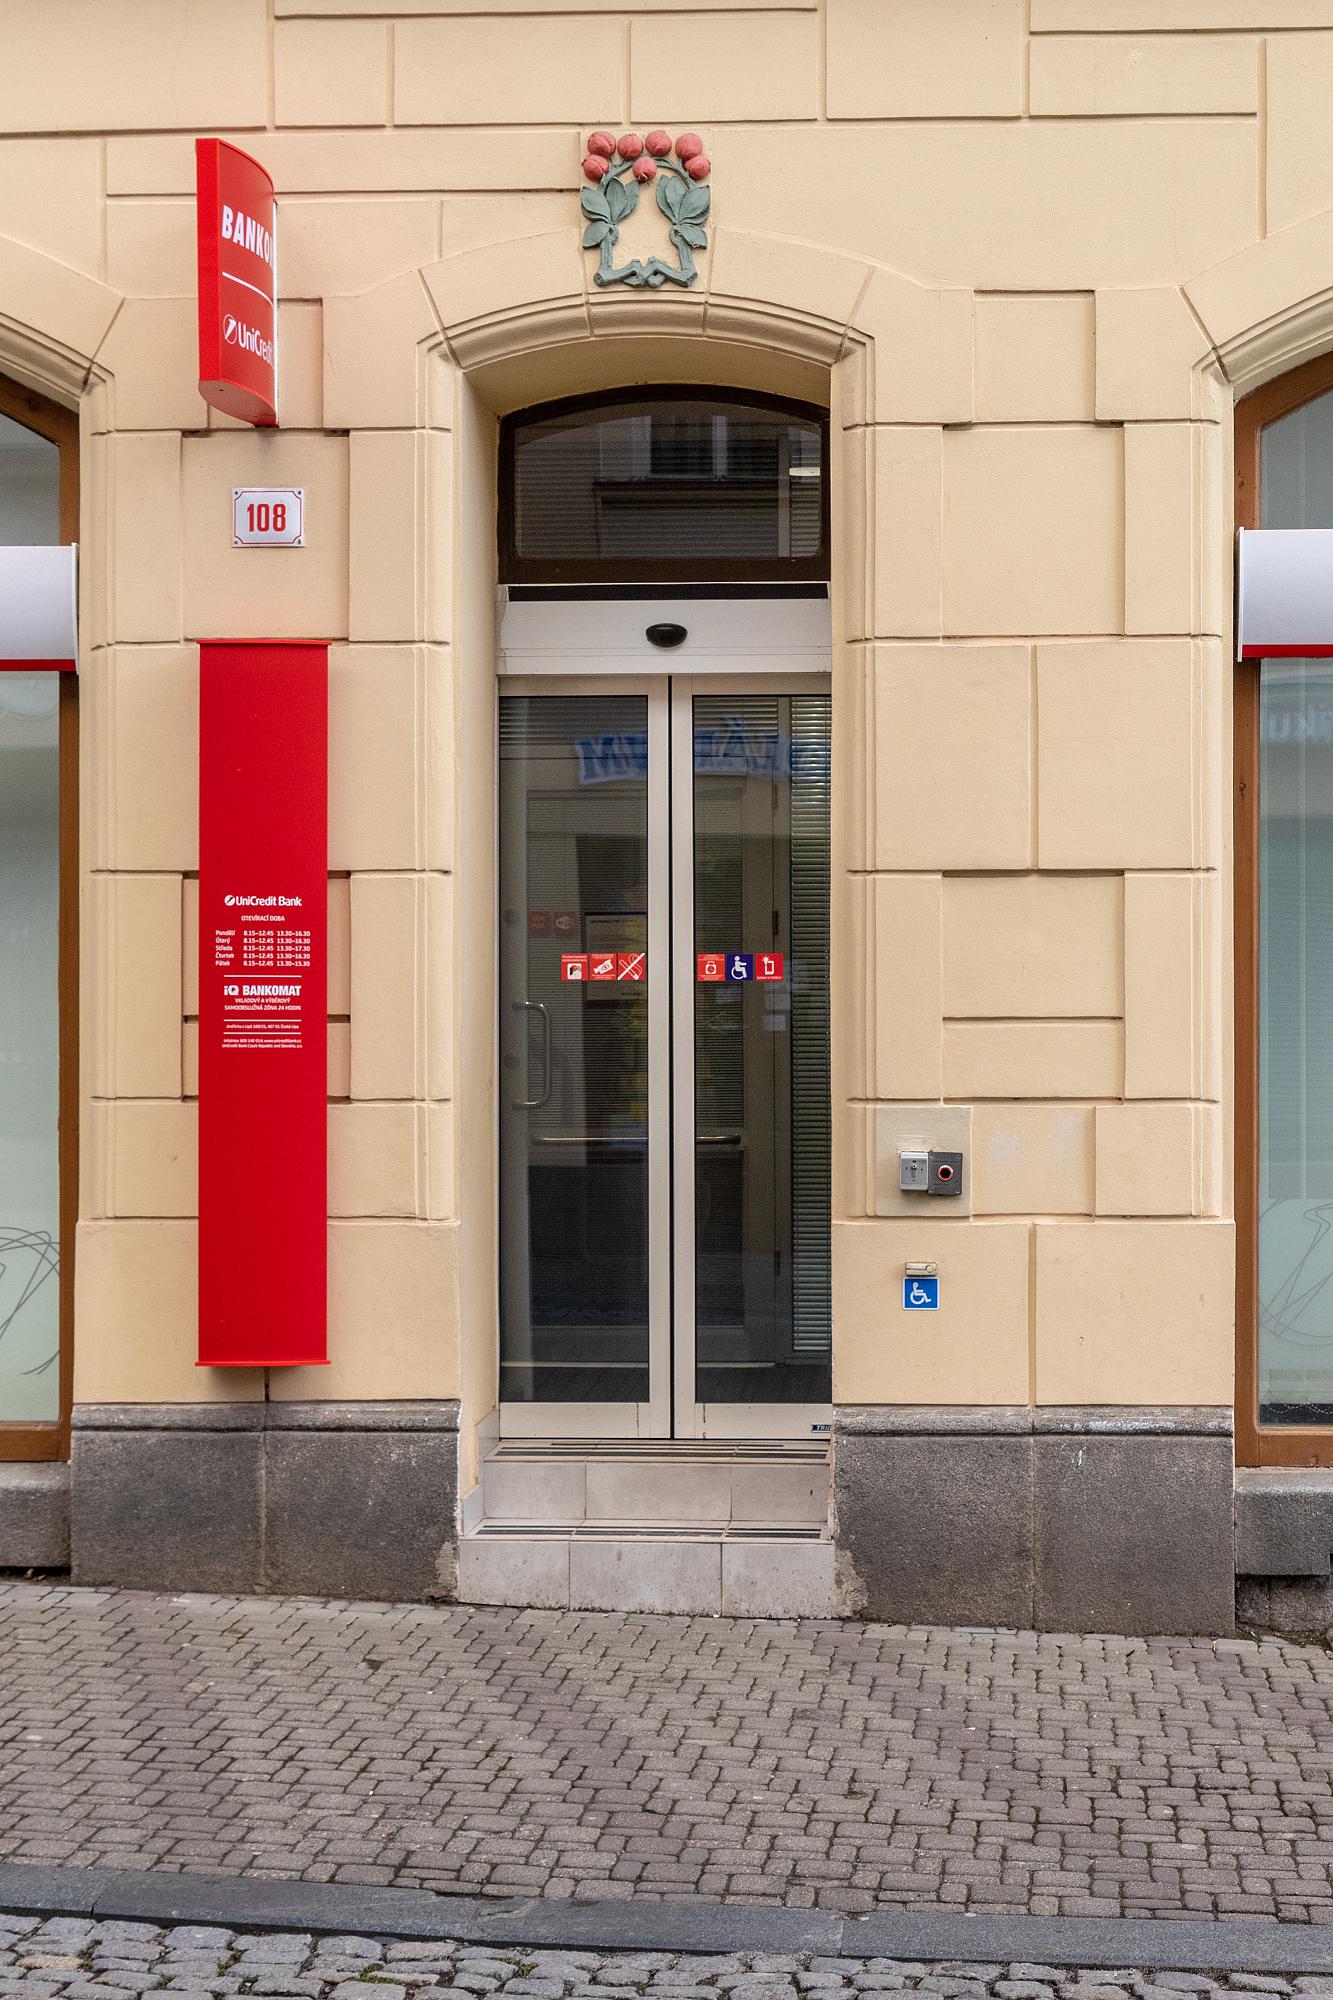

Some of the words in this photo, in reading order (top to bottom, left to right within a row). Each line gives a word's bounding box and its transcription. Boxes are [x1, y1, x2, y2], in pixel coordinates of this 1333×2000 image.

[246, 503, 287, 533] 108
[235, 895, 277, 906] UniCredit
[278, 896, 302, 906] Bank
[223, 985, 240, 996] iQ
[242, 985, 302, 996] BANKOMAT
